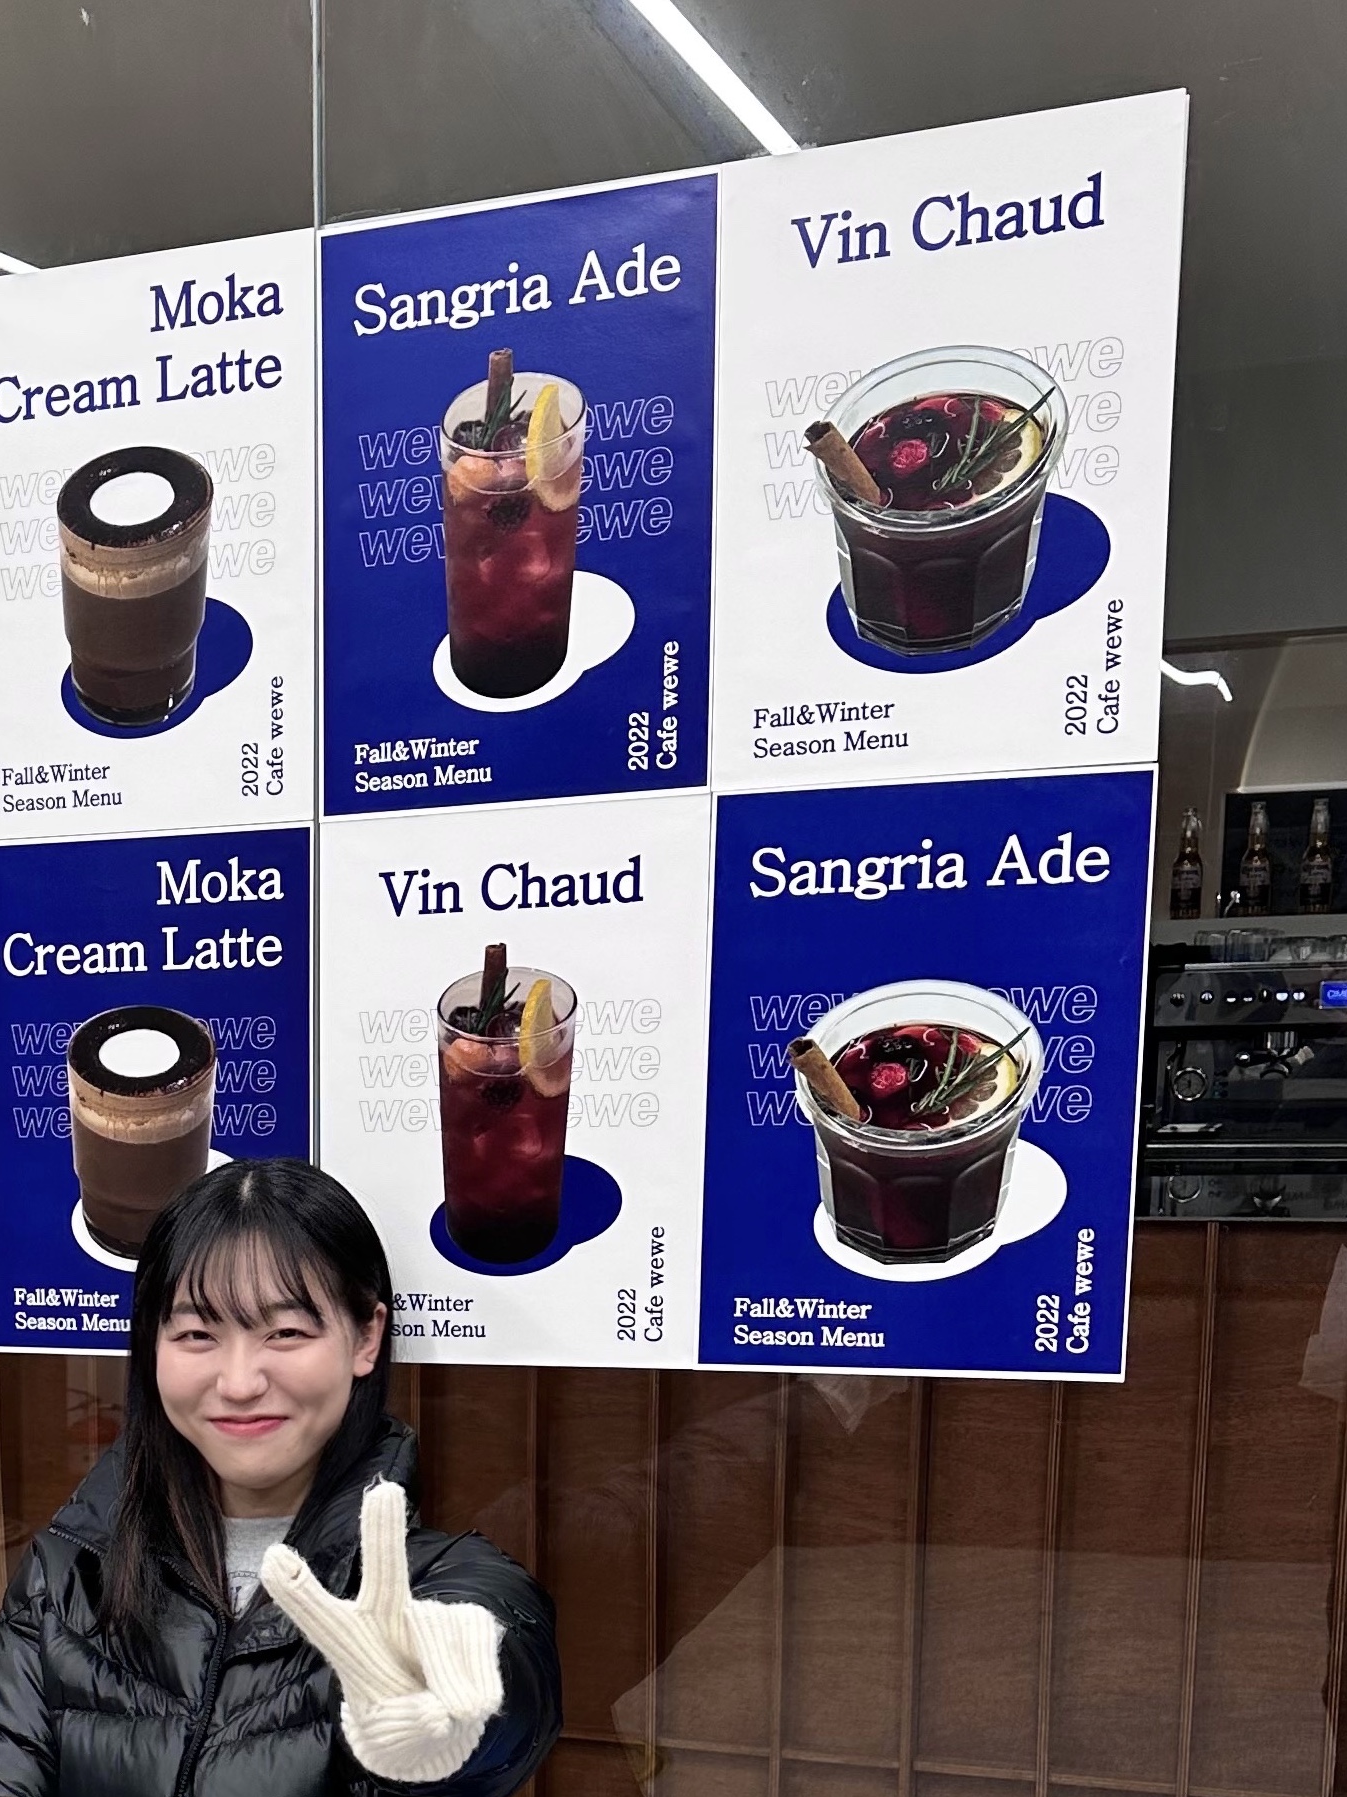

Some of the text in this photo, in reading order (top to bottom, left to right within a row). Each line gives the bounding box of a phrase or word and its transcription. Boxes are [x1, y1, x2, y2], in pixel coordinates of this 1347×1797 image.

[790, 170, 1105, 269] Vin Chaud
[149, 272, 285, 333] Moka
[353, 242, 681, 337] Sangria Ade
[155, 349, 283, 403] Latte
[1096, 599, 1124, 734] Cafe wewe
[655, 640, 680, 770] Cafe wewe
[753, 701, 895, 730] Fall&Winter
[1064, 674, 1088, 736] 2022
[265, 675, 284, 796] Cafe wewe
[354, 737, 480, 765] Fall&Winter
[627, 711, 650, 771] 2022
[753, 729, 909, 759] Season Menu
[1, 763, 111, 787] Fall&Winter
[241, 742, 259, 797] 2022
[354, 764, 493, 793] Season Menu
[2, 788, 123, 813] Season Menu
[156, 856, 285, 906] Moka
[378, 854, 644, 918] Vin Chaud
[749, 831, 1110, 901] Sangria Ade
[3, 926, 283, 977] Cream Latte
[13, 1287, 120, 1308] Fall&Winter
[392, 1293, 474, 1312] &Winter
[643, 1226, 665, 1342] Cafe wewe
[733, 1297, 873, 1320] Fall&Winter
[1065, 1228, 1095, 1354] Cafe wewe
[14, 1311, 131, 1332] Season Menu
[391, 1319, 486, 1338] son Menu
[616, 1288, 636, 1342] 2022
[733, 1324, 886, 1348] Season Menu
[1034, 1294, 1060, 1353] 2022
